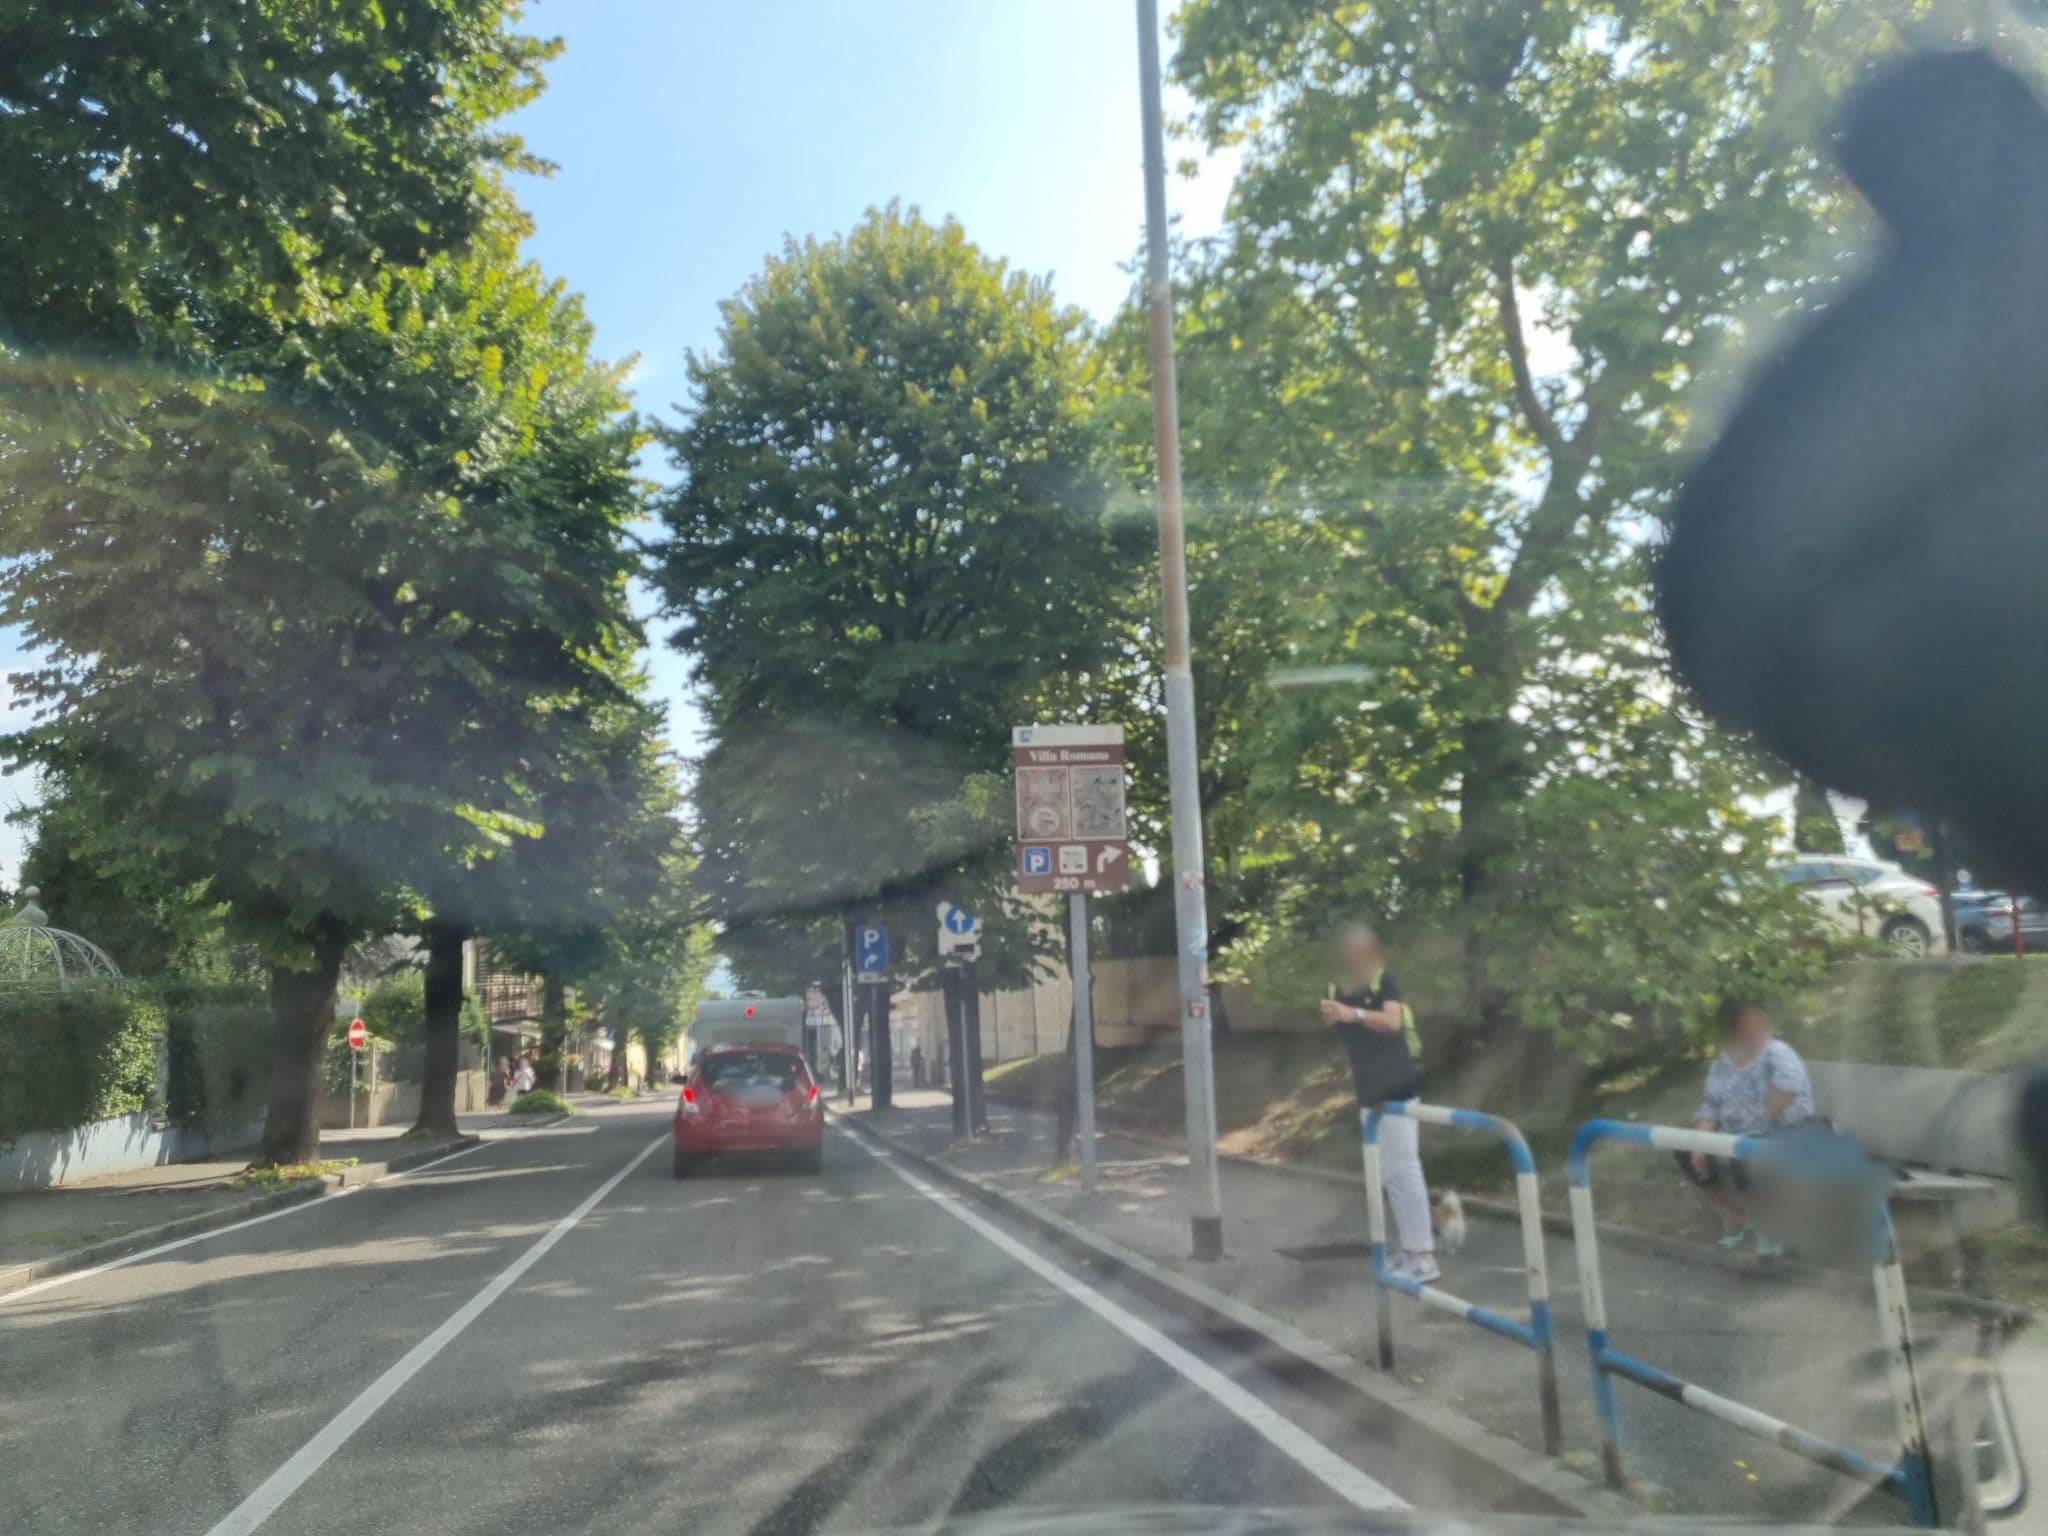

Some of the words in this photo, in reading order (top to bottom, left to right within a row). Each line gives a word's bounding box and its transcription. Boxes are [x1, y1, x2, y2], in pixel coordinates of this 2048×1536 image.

[1029, 750, 1058, 762] Villa
[1060, 749, 1110, 761] Romana
[1030, 854, 1045, 873] P
[863, 929, 880, 949] P
